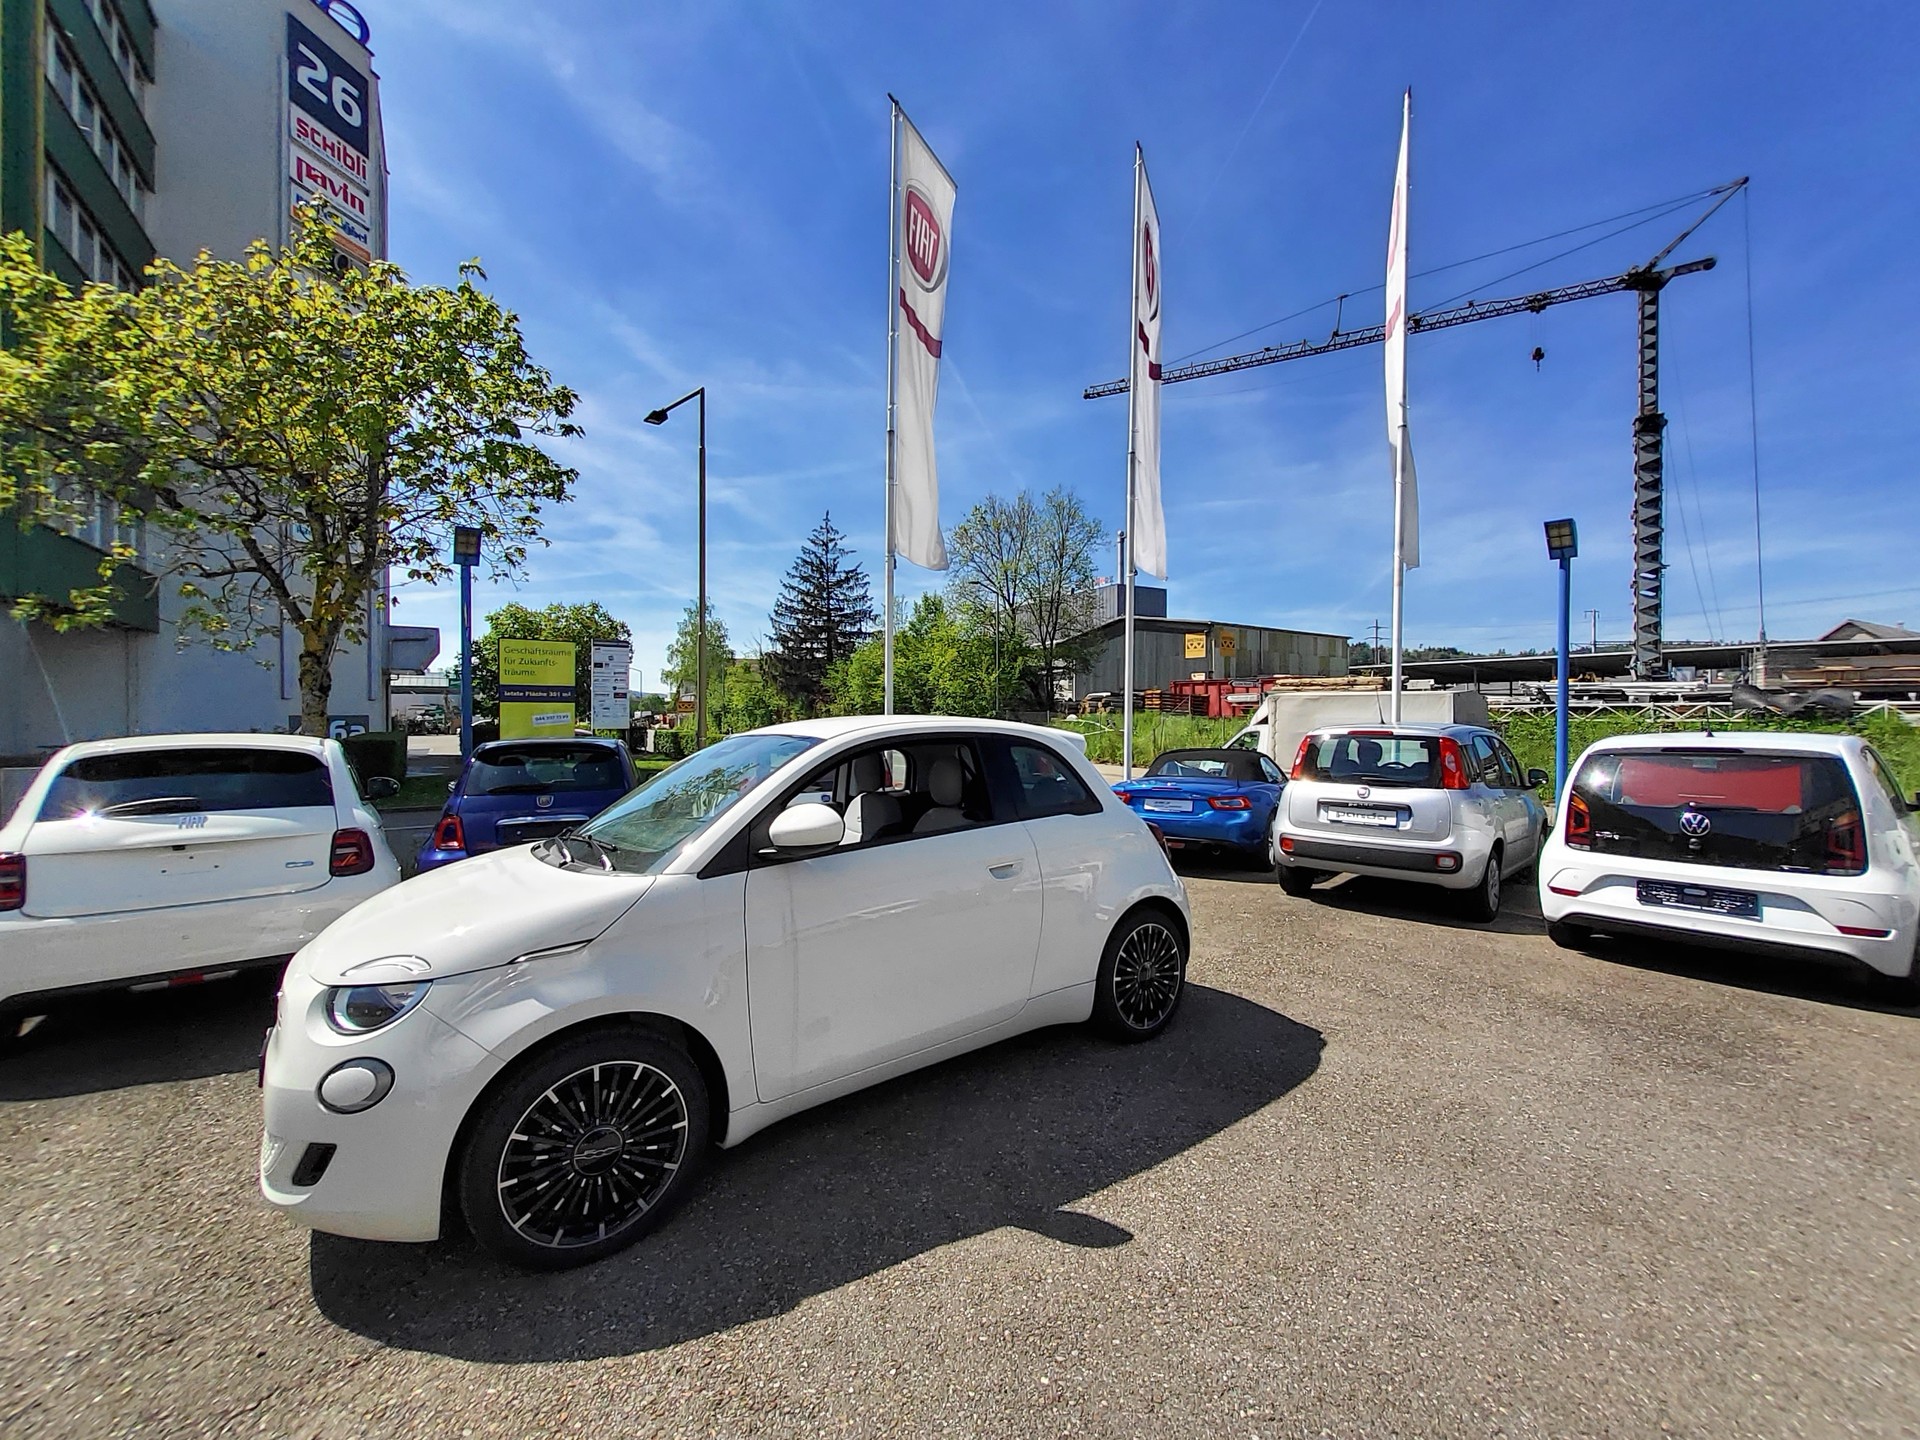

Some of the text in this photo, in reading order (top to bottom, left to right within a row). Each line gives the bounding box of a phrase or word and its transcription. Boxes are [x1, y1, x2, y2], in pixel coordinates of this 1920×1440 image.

[297, 41, 362, 128] 26
[909, 203, 938, 270] FIAT
[503, 656, 558, 667] für Zukunfts-
[178, 815, 208, 829] FIAT
[1336, 811, 1389, 821] panda
